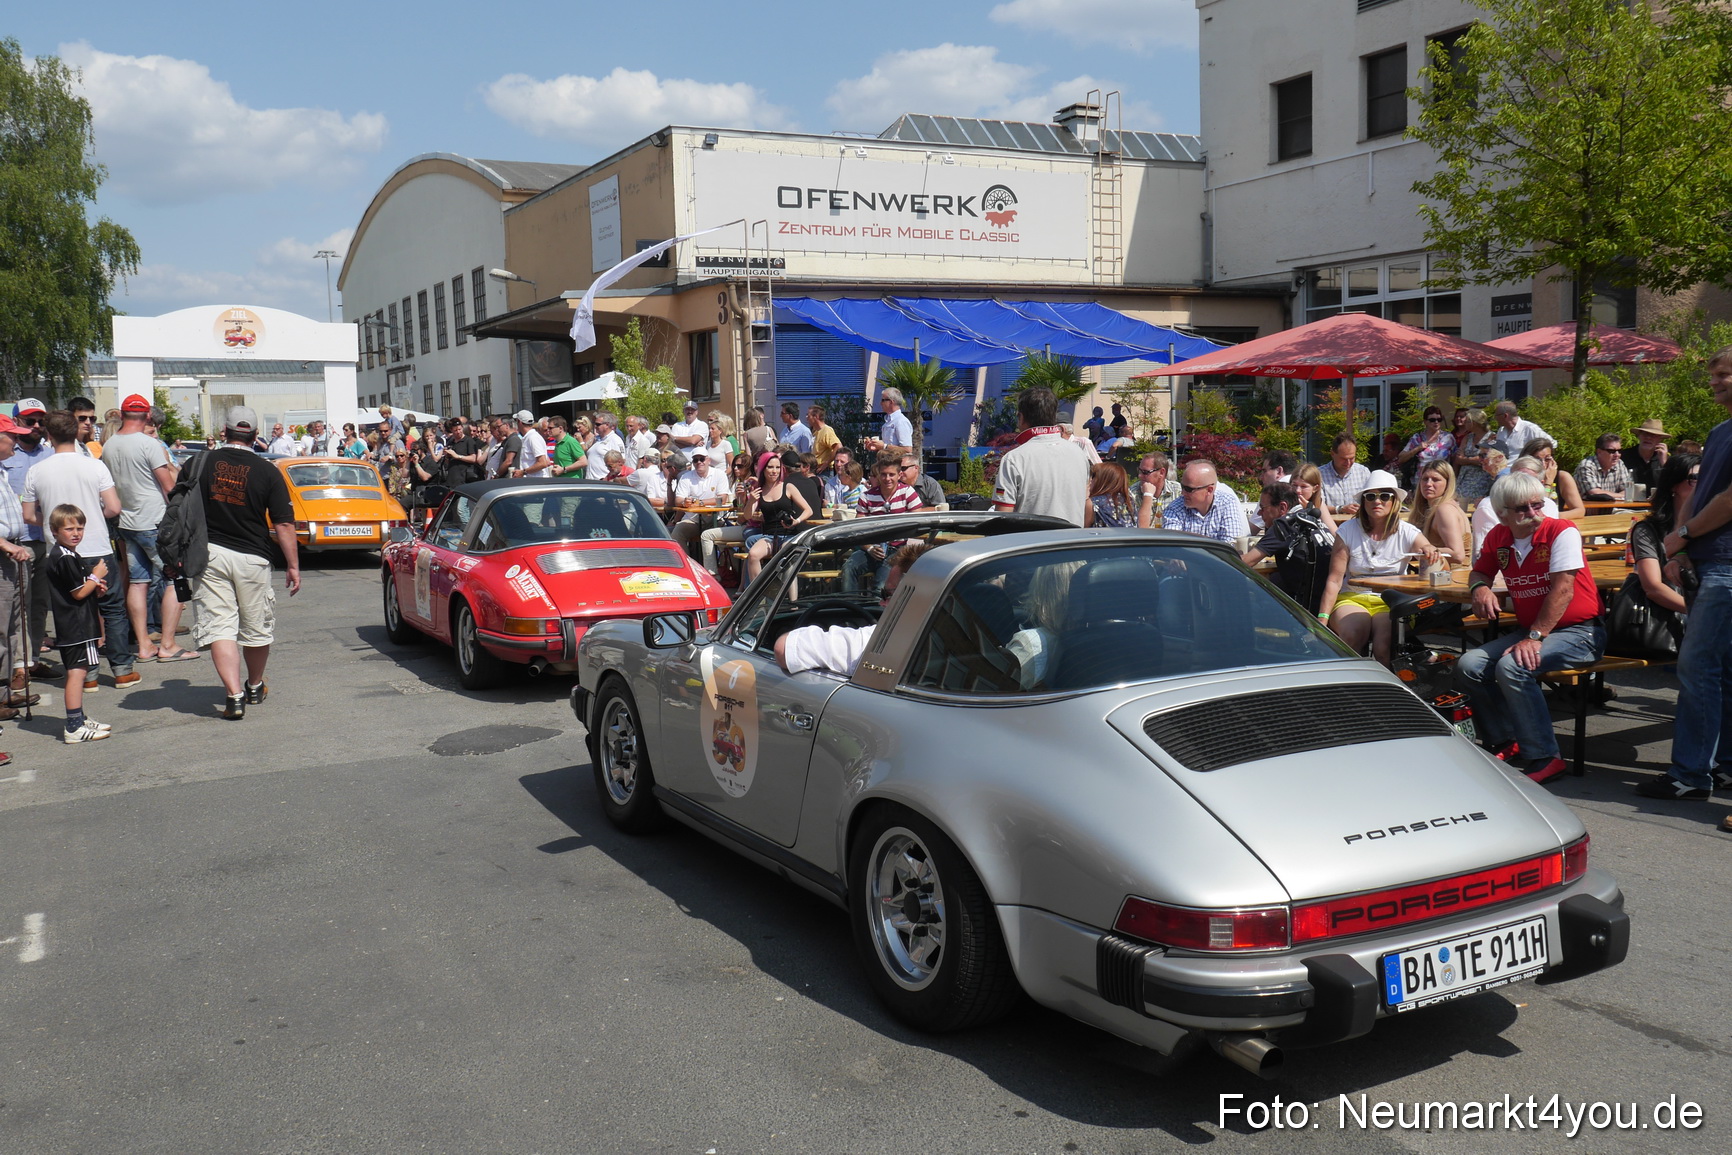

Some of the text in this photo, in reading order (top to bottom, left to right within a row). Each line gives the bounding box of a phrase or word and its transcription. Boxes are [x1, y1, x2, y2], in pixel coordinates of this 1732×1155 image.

[777, 185, 979, 218] OFENWERK
[778, 221, 856, 237] ZENTRUM
[898, 226, 954, 241] MOBILE
[959, 228, 1020, 243] CLASSIC
[698, 256, 772, 264] OFENWERK
[703, 268, 780, 276] HAUPTEINGANG
[230, 310, 247, 319] ZIEL
[717, 291, 729, 325] 3
[1031, 426, 1048, 435] Mille
[214, 460, 251, 476] Gulf
[329, 527, 372, 535] N MM 694H
[514, 569, 541, 599] MARKT
[714, 693, 745, 708] PORSCHE
[1343, 811, 1489, 846] PORSCHE
[1331, 868, 1540, 929] PORSCHE
[1403, 923, 1546, 995] BA TE 911H
[1390, 983, 1398, 996] D
[1418, 986, 1482, 1008] SPORTWAGEN
[1485, 979, 1508, 990] BAMBERG
